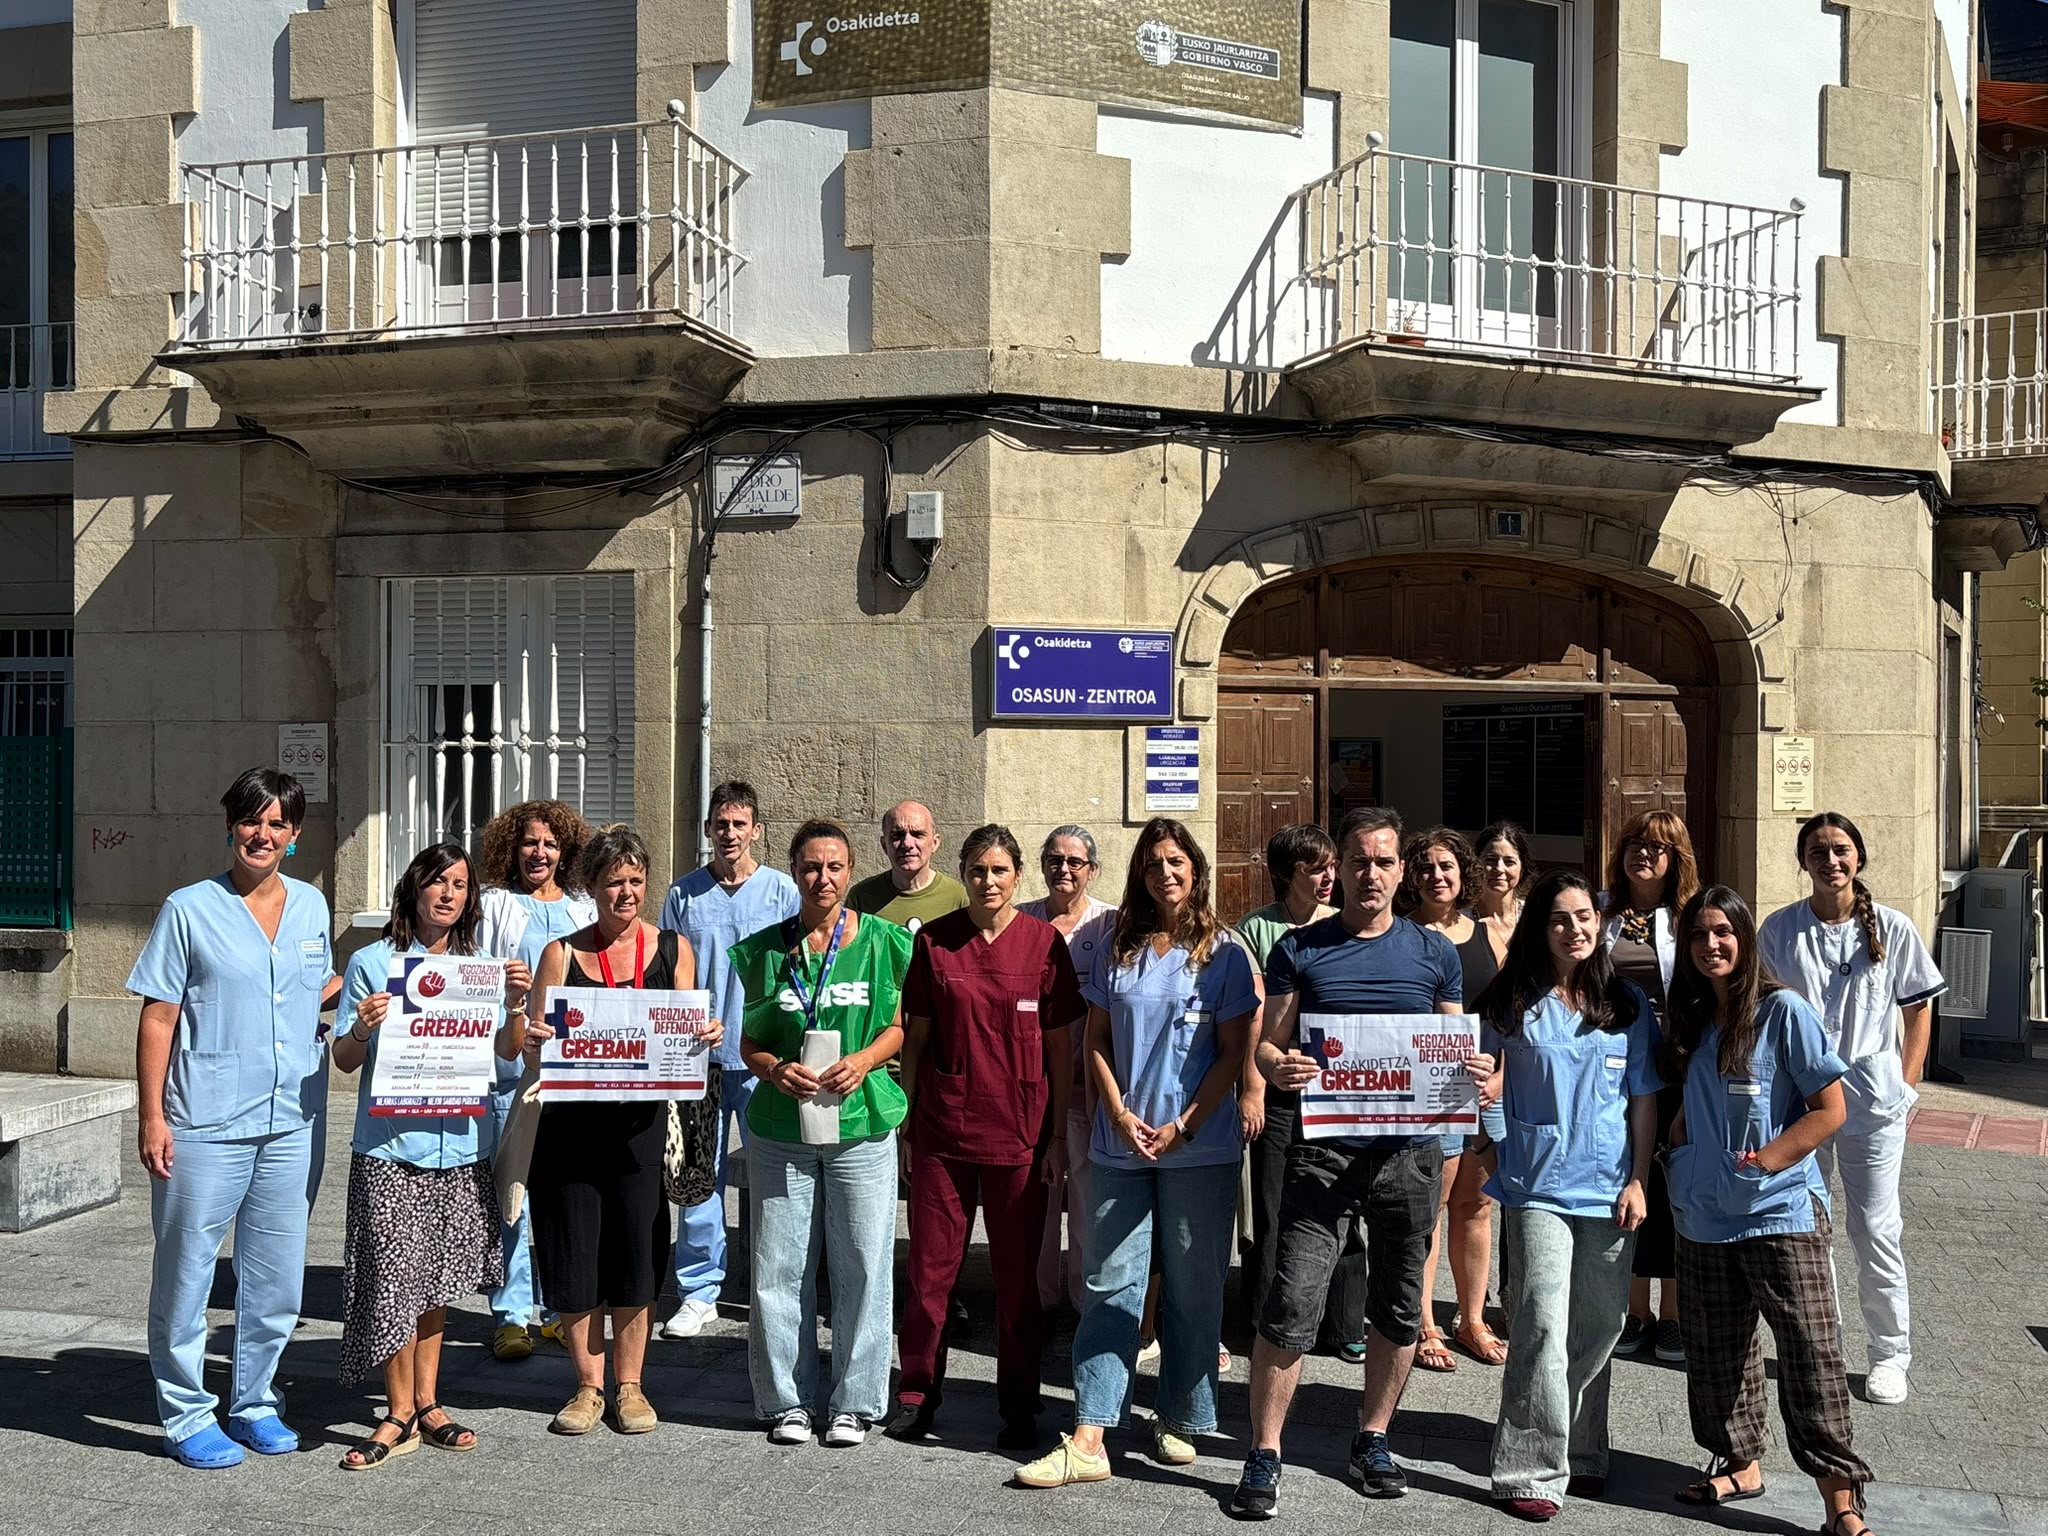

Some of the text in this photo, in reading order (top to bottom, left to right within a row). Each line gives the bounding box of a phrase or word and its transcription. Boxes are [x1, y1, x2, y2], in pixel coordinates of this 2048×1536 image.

[826, 11, 920, 33] Osakidetza
[1182, 38, 1269, 61] EUSKO JAURLARITZA
[1182, 51, 1263, 73] GOBIERNO VASCO
[1034, 636, 1092, 649] Osakidetza
[1012, 688, 1076, 703] OSASUN
[1087, 689, 1157, 704] ZENTROA
[458, 964, 501, 976] NEGOZIAZIOA
[461, 974, 500, 986] DEFENDATU
[465, 986, 498, 997] orain!
[426, 1007, 493, 1020] OSAKIDETZA
[648, 1007, 706, 1021] NEGOZIAZIOA
[409, 1017, 493, 1038] GREBAN!
[573, 1028, 647, 1040] OSAKIDETZA
[1412, 1033, 1475, 1049] NEGOZIAZIOA
[561, 1039, 646, 1060] GREBAN!
[1333, 1056, 1411, 1071] OSAKIDETZA
[1321, 1070, 1411, 1091] GREBAN!
